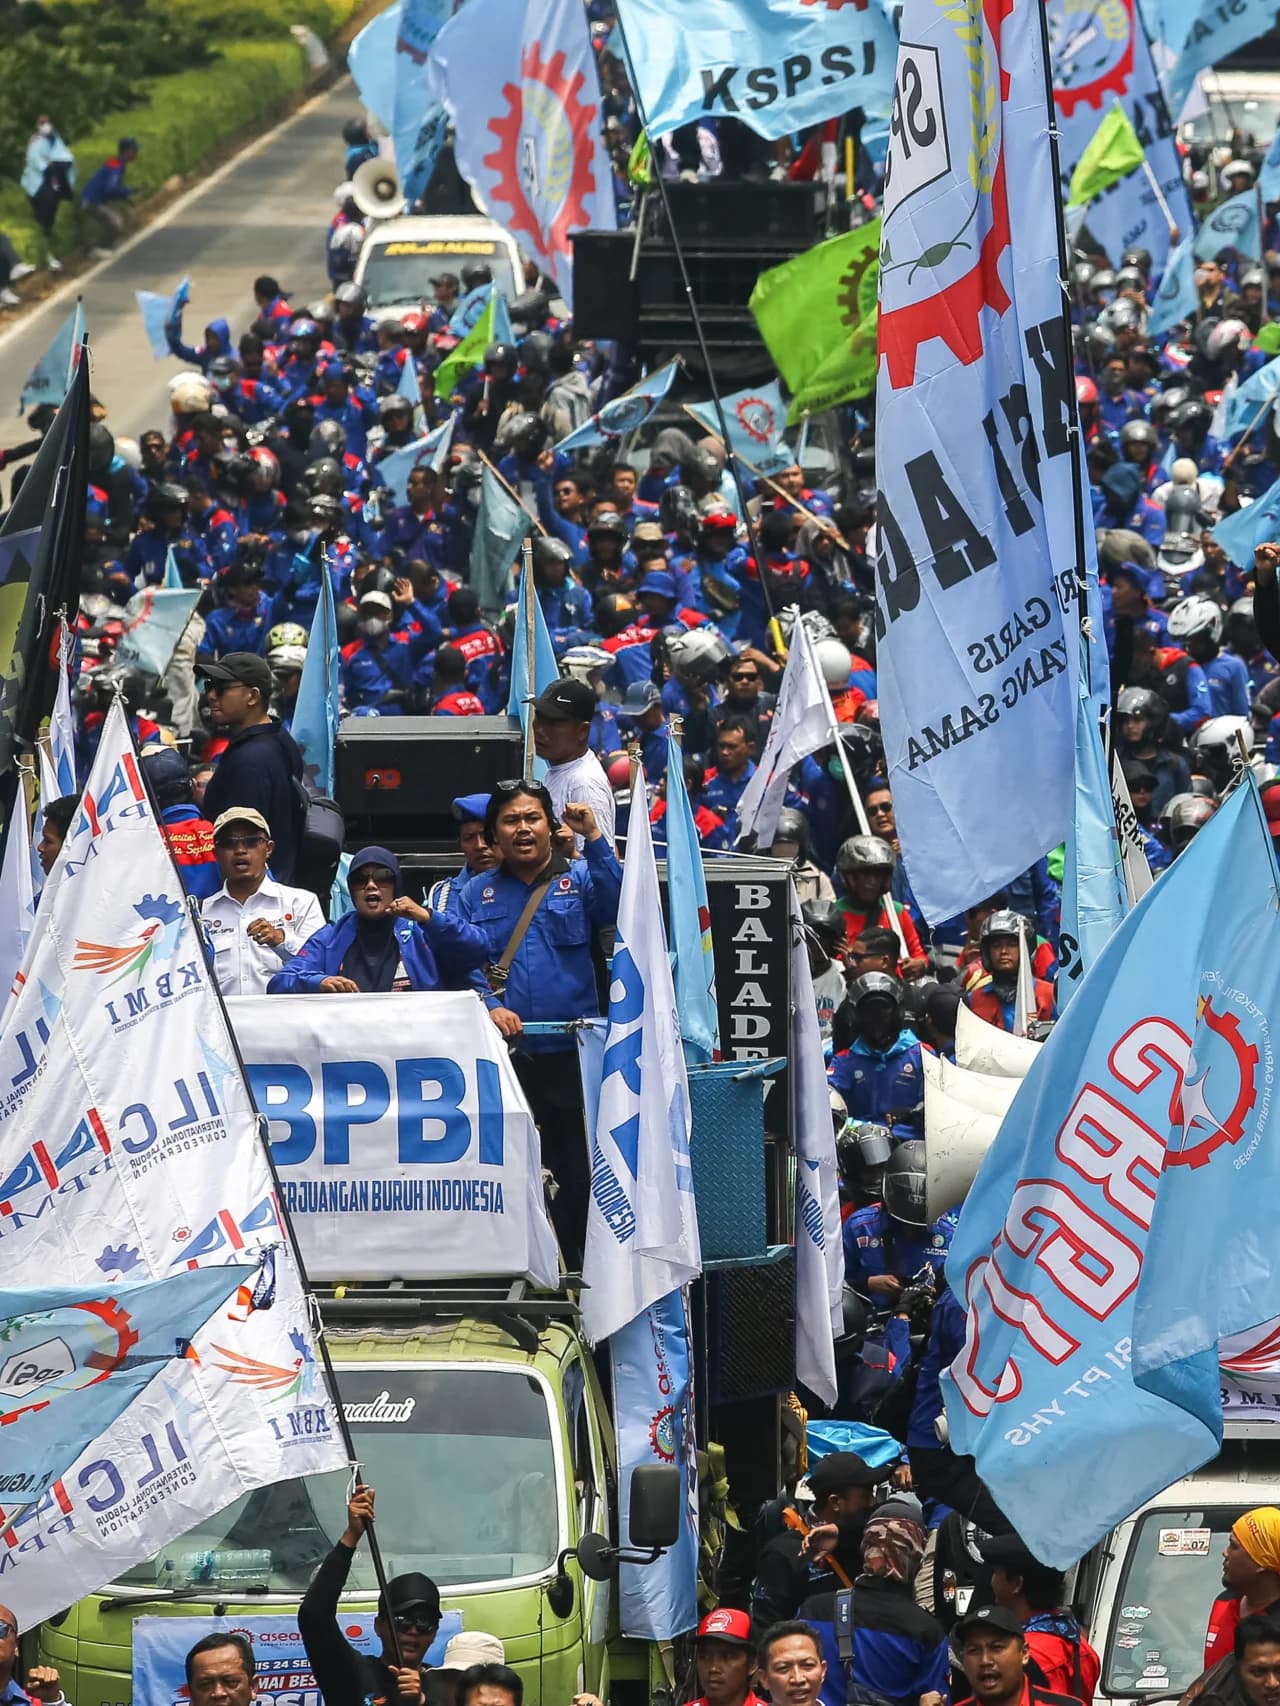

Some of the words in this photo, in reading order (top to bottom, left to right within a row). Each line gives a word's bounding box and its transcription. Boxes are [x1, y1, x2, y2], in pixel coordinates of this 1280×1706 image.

[700, 40, 876, 112] KSPSI
[243, 1057, 504, 1166] BPBI
[279, 1180, 368, 1212] ERJUANGAN
[371, 1180, 423, 1211] BURUH
[426, 1179, 504, 1214] INDONESIA
[592, 1166, 637, 1245] INDONESIA
[273, 1660, 291, 1670] 24
[289, 1673, 317, 1688] BES
